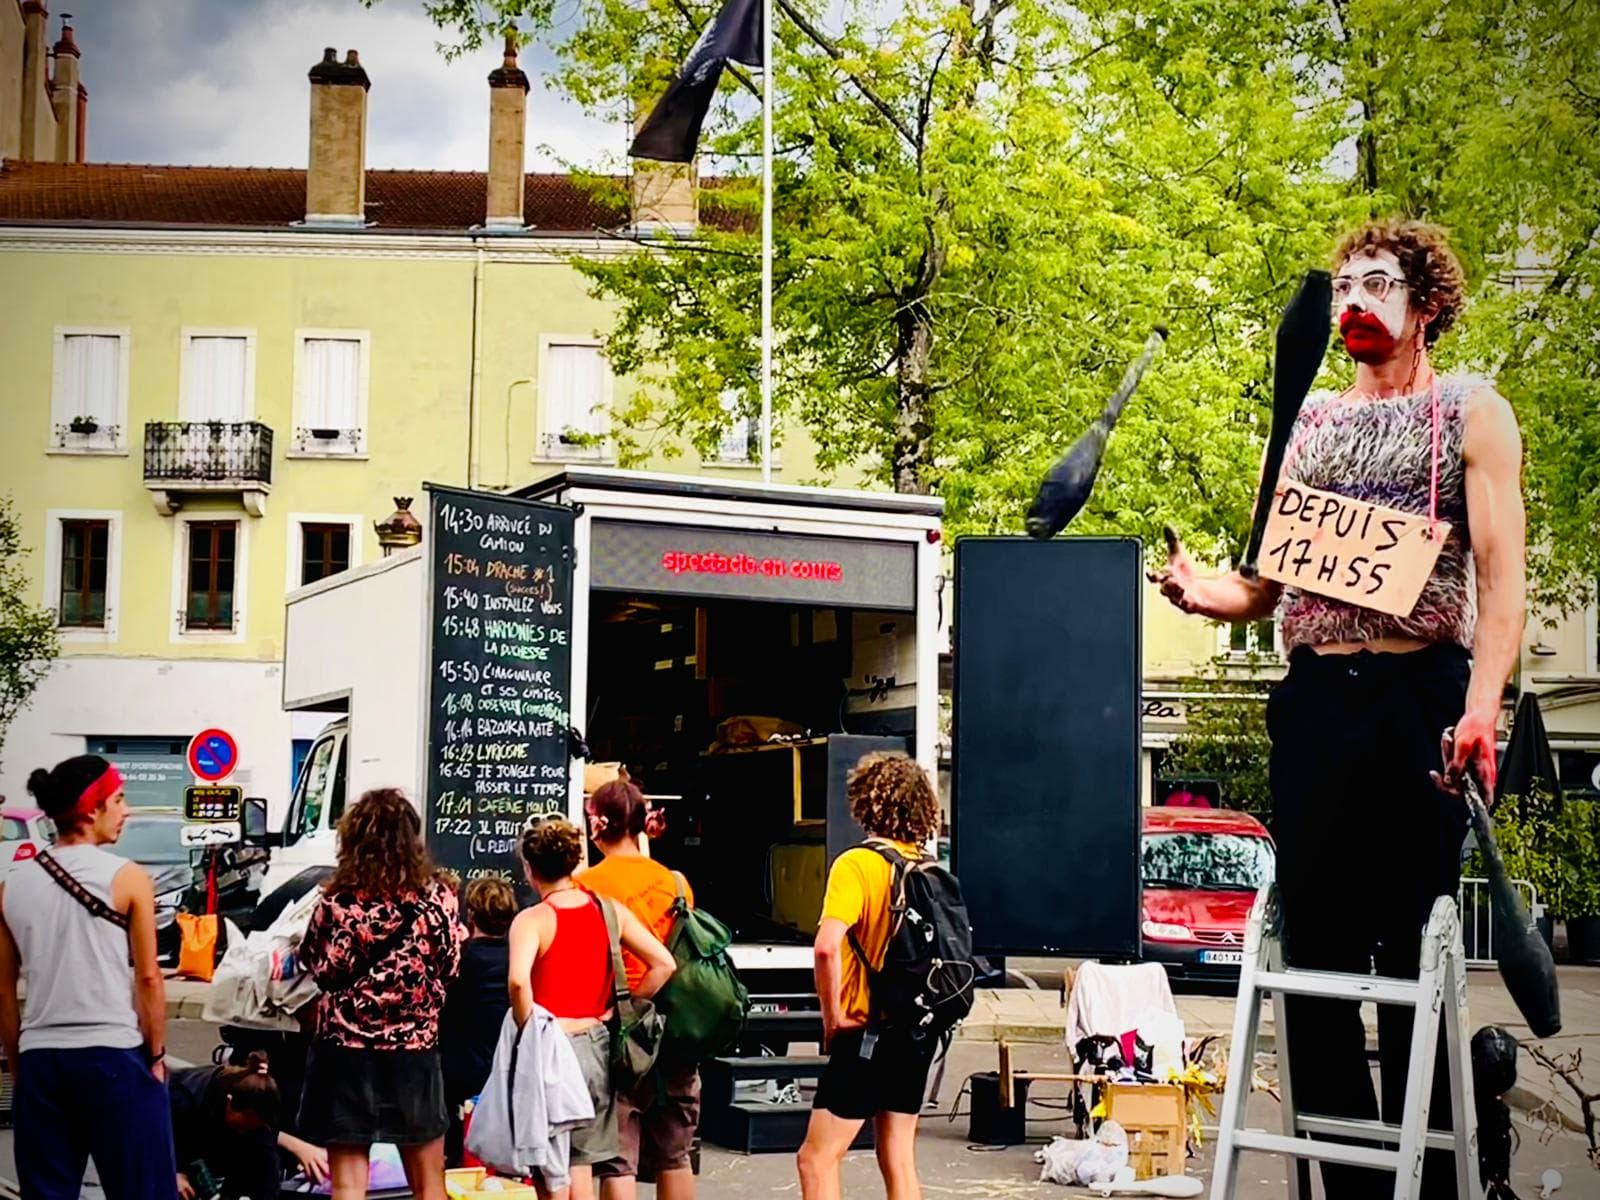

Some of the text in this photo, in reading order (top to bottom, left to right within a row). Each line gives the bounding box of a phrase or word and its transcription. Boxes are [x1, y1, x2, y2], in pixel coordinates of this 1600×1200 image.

[439, 504, 484, 535] 14:30
[479, 533, 525, 553] CAMION
[663, 552, 759, 574] spectacle
[790, 561, 842, 580] cours
[443, 586, 563, 615] 15:40 INSTALLEZ VOUS
[442, 615, 480, 639] 15:48
[549, 629, 567, 645] DE
[484, 641, 498, 655] LA
[439, 660, 479, 684] 15:50
[477, 717, 526, 737] BAZOOKA
[440, 743, 475, 762] 16:23
[476, 764, 491, 778] JE
[496, 764, 537, 779] JONGLE
[541, 765, 565, 779] POUR
[475, 780, 566, 798] PASSER LE TEMPS
[435, 817, 472, 834] 17:22
